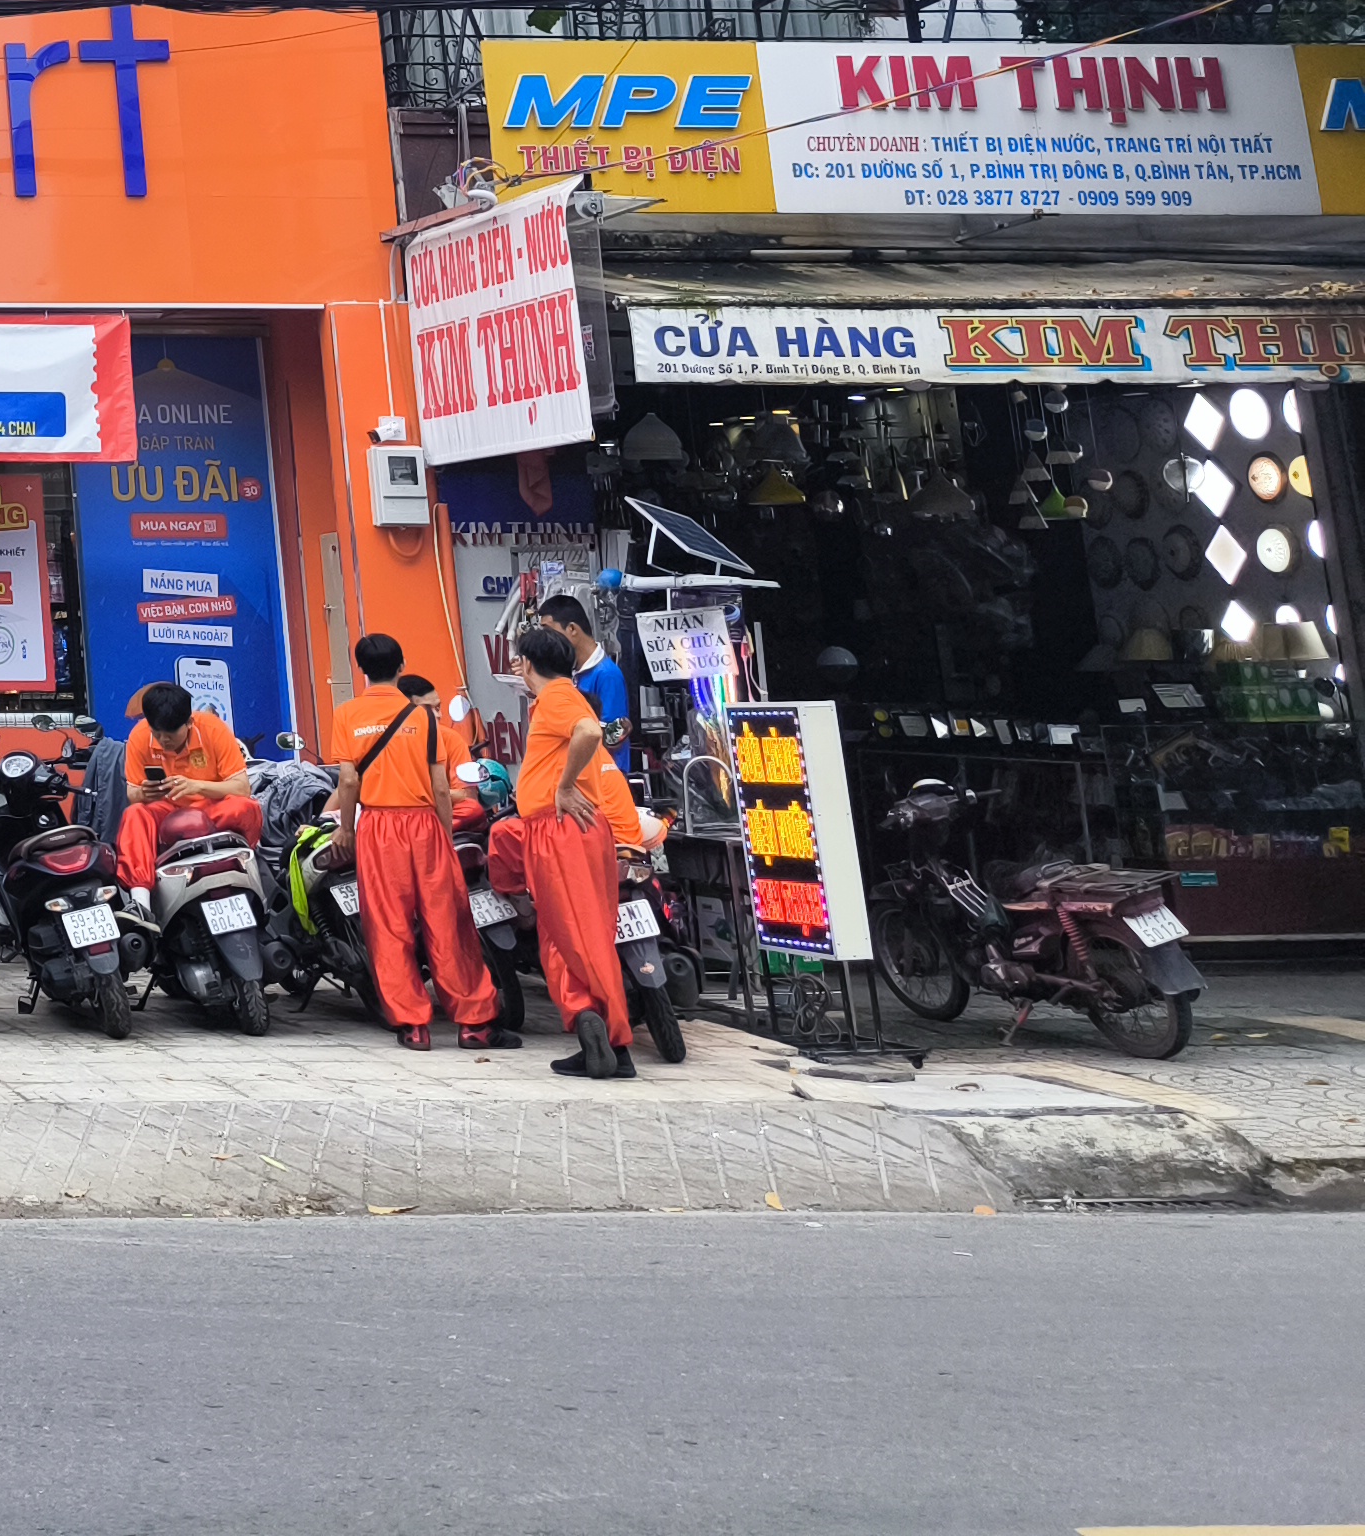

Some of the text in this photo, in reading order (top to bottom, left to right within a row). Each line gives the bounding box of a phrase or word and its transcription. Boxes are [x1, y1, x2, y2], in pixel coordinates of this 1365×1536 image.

[503, 73, 753, 129] MPE
[836, 53, 1229, 127] KIM THỊNH
[807, 132, 1274, 156] CHUYÊN DOANH THIẾT BỊ ĐIỆN TRANG TRÍ NỘI THẤT
[518, 135, 742, 180] THIẾT BỊ ĐIỆN
[825, 157, 1302, 183] 201 ĐƯỜNG SỐ P.BÌNH TRỊ ĐÔNG Q.BÌNH TP.HCM
[937, 190, 1193, 208] 028 3877 8727 0909 599 909
[478, 196, 569, 298] ĐIỆN NƯỚC
[654, 313, 1151, 371] CỬA HÀNG KIM
[417, 288, 583, 426] KIM THỊNH
[657, 363, 679, 374] 201
[157, 403, 233, 425] ONLINE
[8, 420, 36, 436] CHAI
[140, 434, 215, 452] GẶP TRÀN
[110, 459, 240, 503] ƯU ĐÃI
[140, 520, 203, 532] MUA NGAY
[451, 521, 503, 546] KIM
[150, 572, 213, 593] NẮNG MƯA
[185, 679, 225, 691] OneLife
[207, 897, 245, 917] 50-AC
[211, 914, 255, 933] 804.13
[1142, 921, 1183, 944] 5012
